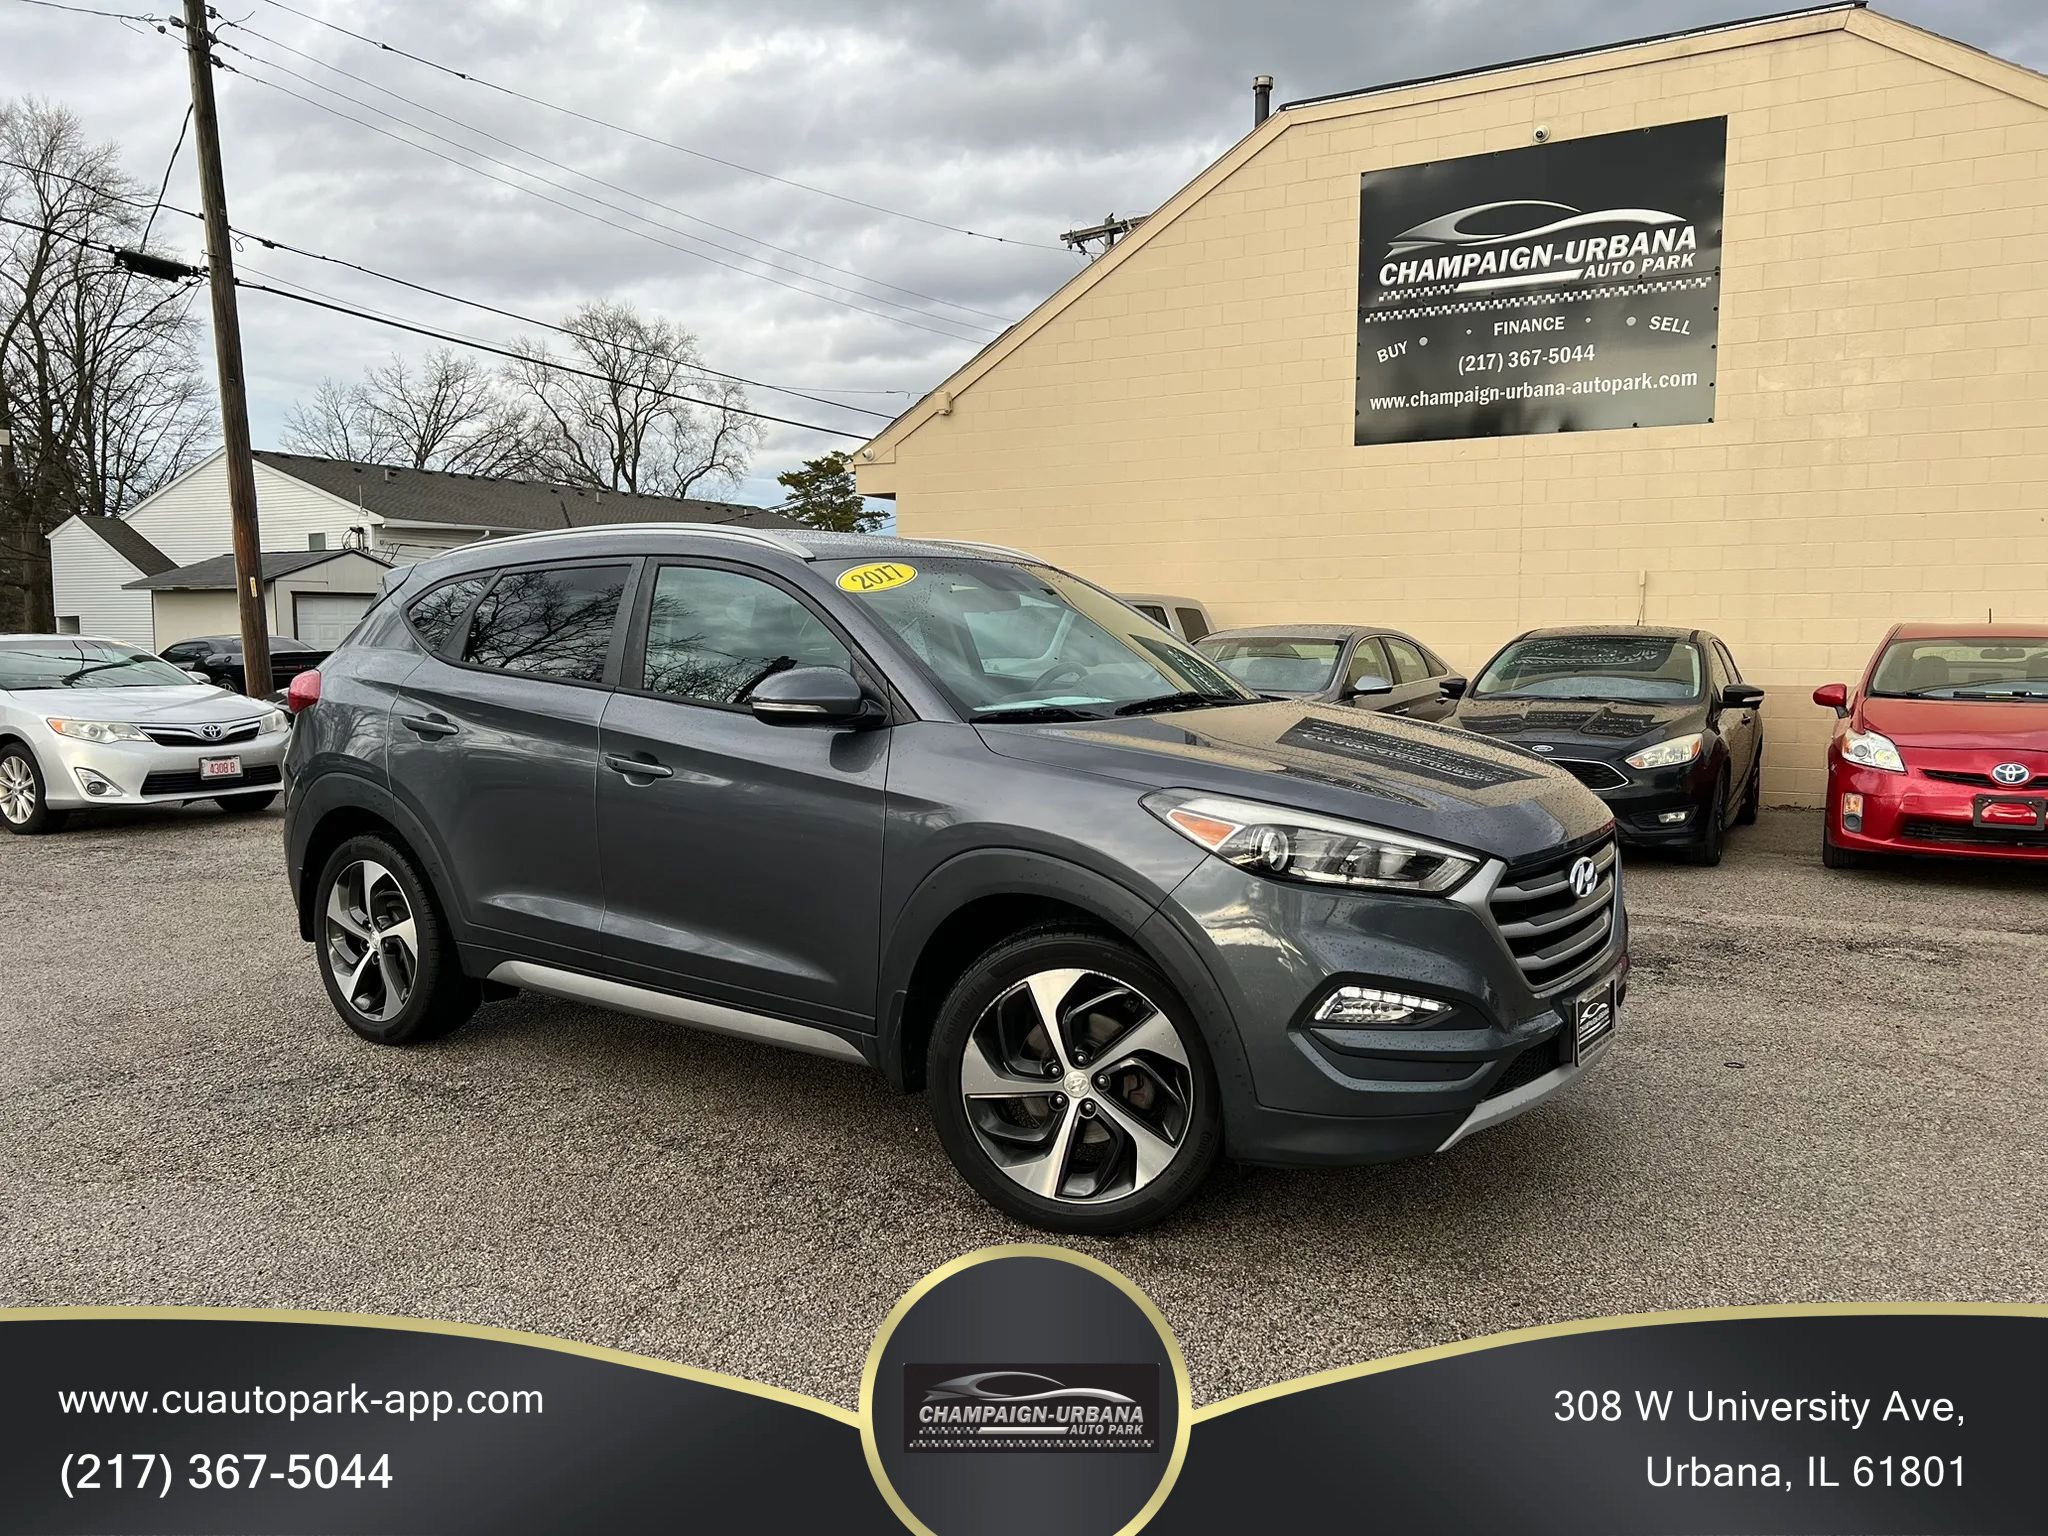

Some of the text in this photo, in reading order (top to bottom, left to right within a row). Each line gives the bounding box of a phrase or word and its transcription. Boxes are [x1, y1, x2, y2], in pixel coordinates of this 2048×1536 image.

[1378, 226, 1697, 286] CHAMPAIGN-URBANA
[1583, 252, 1696, 280] AUTO PARK
[1493, 316, 1566, 337] FINANCE
[1648, 315, 1692, 336] SELL
[1377, 340, 1409, 363] BUY
[1458, 344, 1596, 376] (217) 367-5044
[1369, 371, 1698, 411] www.champaign-urbana-autopark.com
[851, 564, 904, 590] 2017
